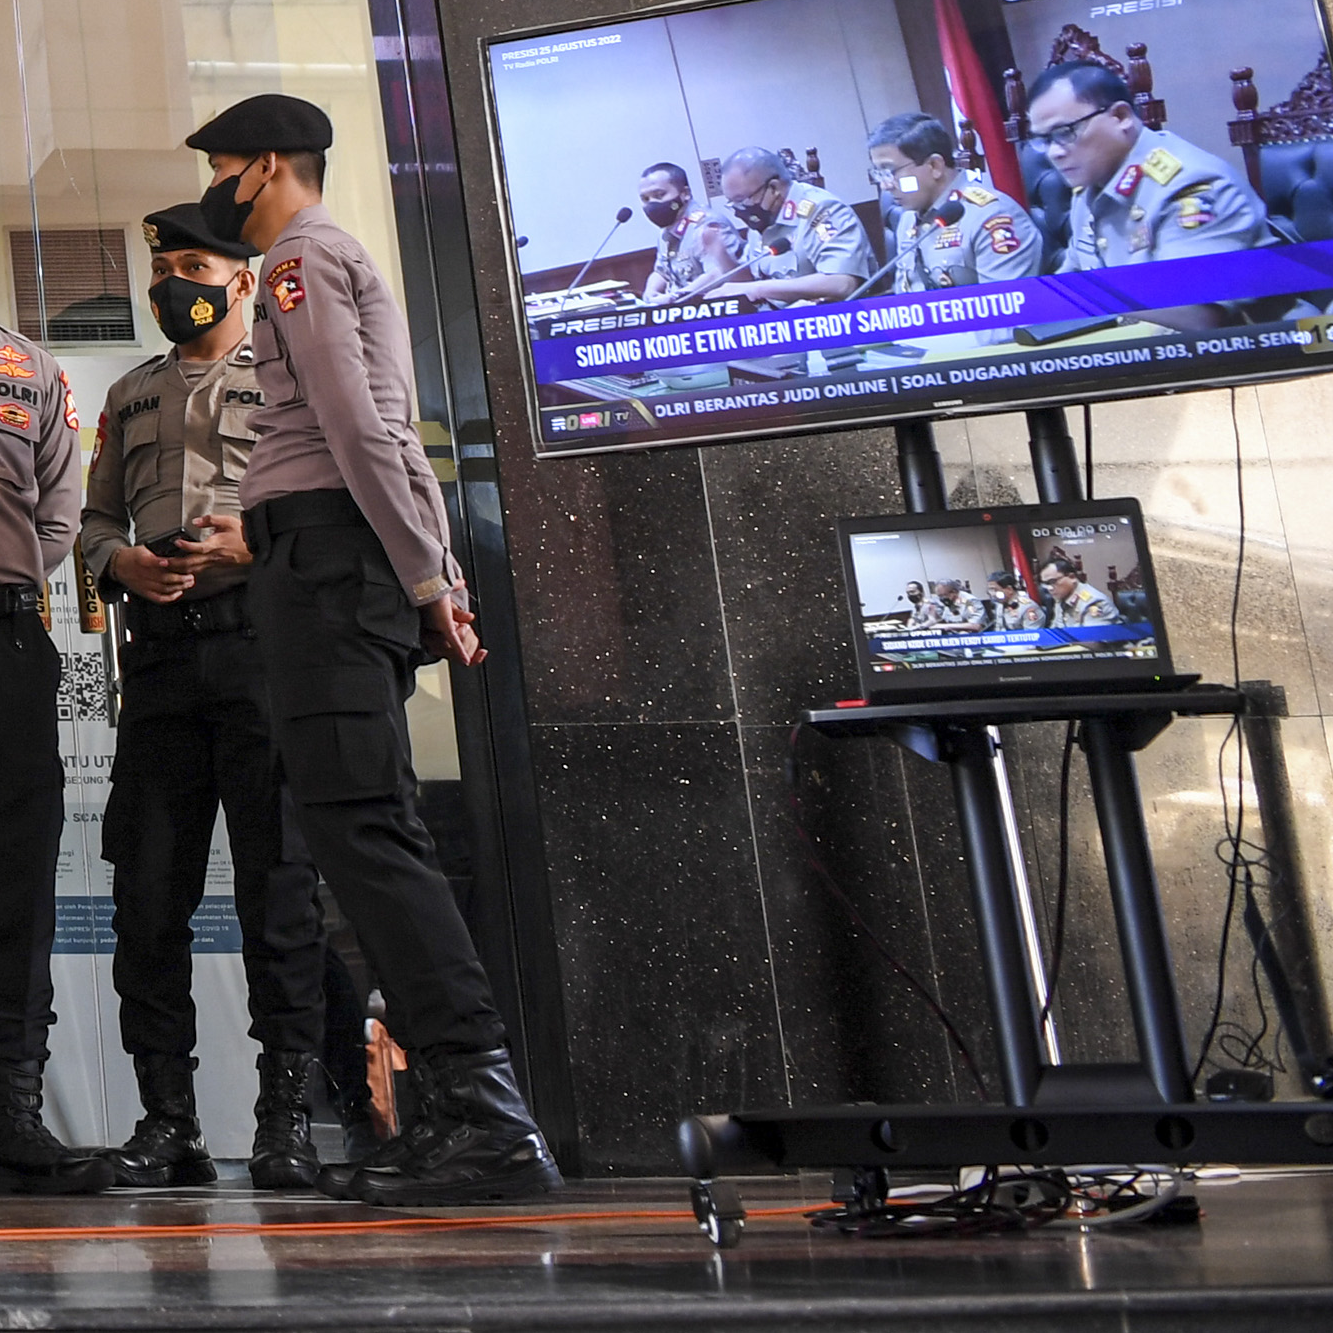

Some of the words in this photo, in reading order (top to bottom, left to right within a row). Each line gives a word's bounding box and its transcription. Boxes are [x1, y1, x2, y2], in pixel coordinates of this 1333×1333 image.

[501, 48, 538, 61] PRESISI
[539, 45, 551, 55] 25
[552, 38, 597, 53] AGUSTUS
[597, 34, 622, 47] 2022
[503, 62, 514, 70] TV
[536, 55, 559, 66] POLRI
[549, 312, 646, 337] PRESISI
[652, 299, 740, 325] UPDATE
[575, 339, 642, 368] SIDANG
[645, 332, 692, 360] KODE
[695, 326, 735, 354] ETIK
[739, 319, 792, 348] IRJEN
[794, 311, 853, 342] FERDY
[857, 303, 925, 334] SAMBO
[926, 290, 1027, 325] TERTUTUP
[655, 398, 691, 418] OLRI
[694, 391, 780, 414] BERANTAS
[782, 386, 821, 405] JUDI
[823, 377, 888, 399] ONLINE
[901, 369, 947, 390] SOAL
[950, 362, 1027, 385] DUGAAN
[1032, 348, 1152, 376] KONSORSIUM
[1155, 342, 1193, 361] 303,
[1195, 334, 1256, 356] POLRI:
[225, 388, 265, 406] POL
